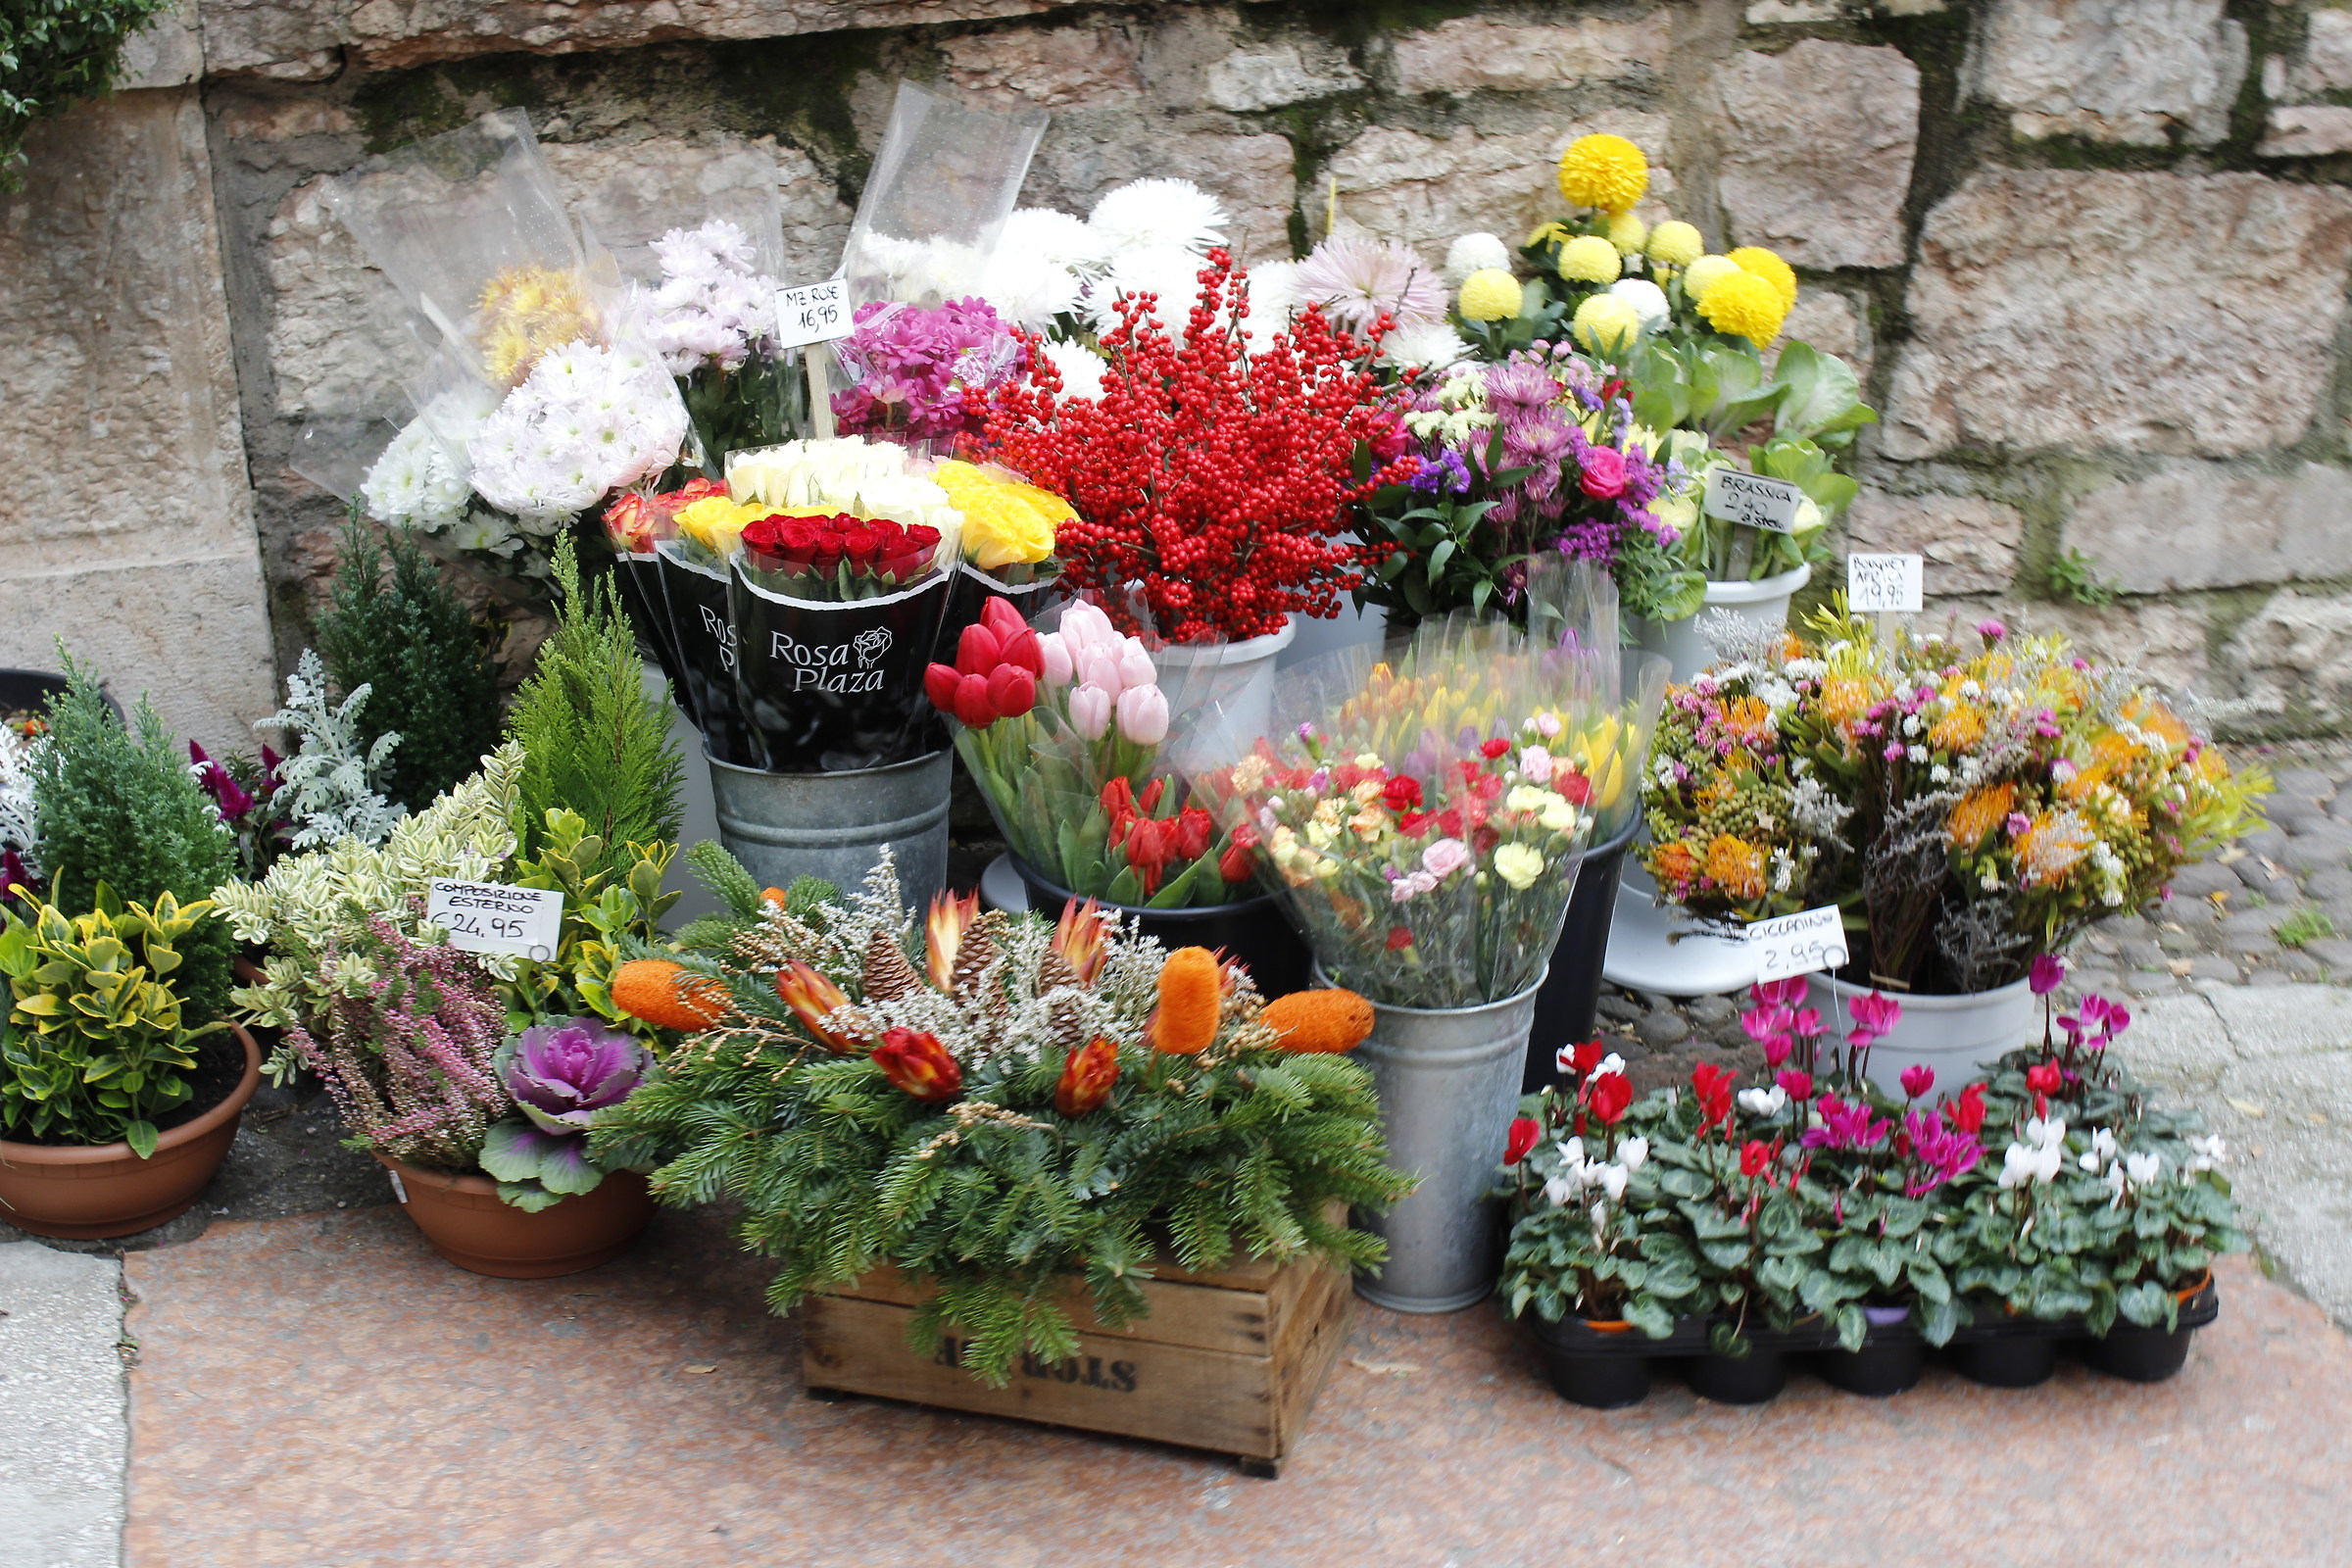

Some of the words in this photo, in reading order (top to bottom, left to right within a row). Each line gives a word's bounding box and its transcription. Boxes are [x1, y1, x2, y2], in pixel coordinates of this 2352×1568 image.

[798, 304, 838, 333] 16,95
[1720, 475, 1792, 504] BRASSICA
[699, 604, 737, 647] Ros
[769, 630, 850, 666] Rosa
[793, 665, 885, 694] Plaza
[434, 882, 544, 903] COMPOSIZIONE
[449, 896, 534, 914] ESTERNO
[1765, 940, 1824, 970] 2,95
